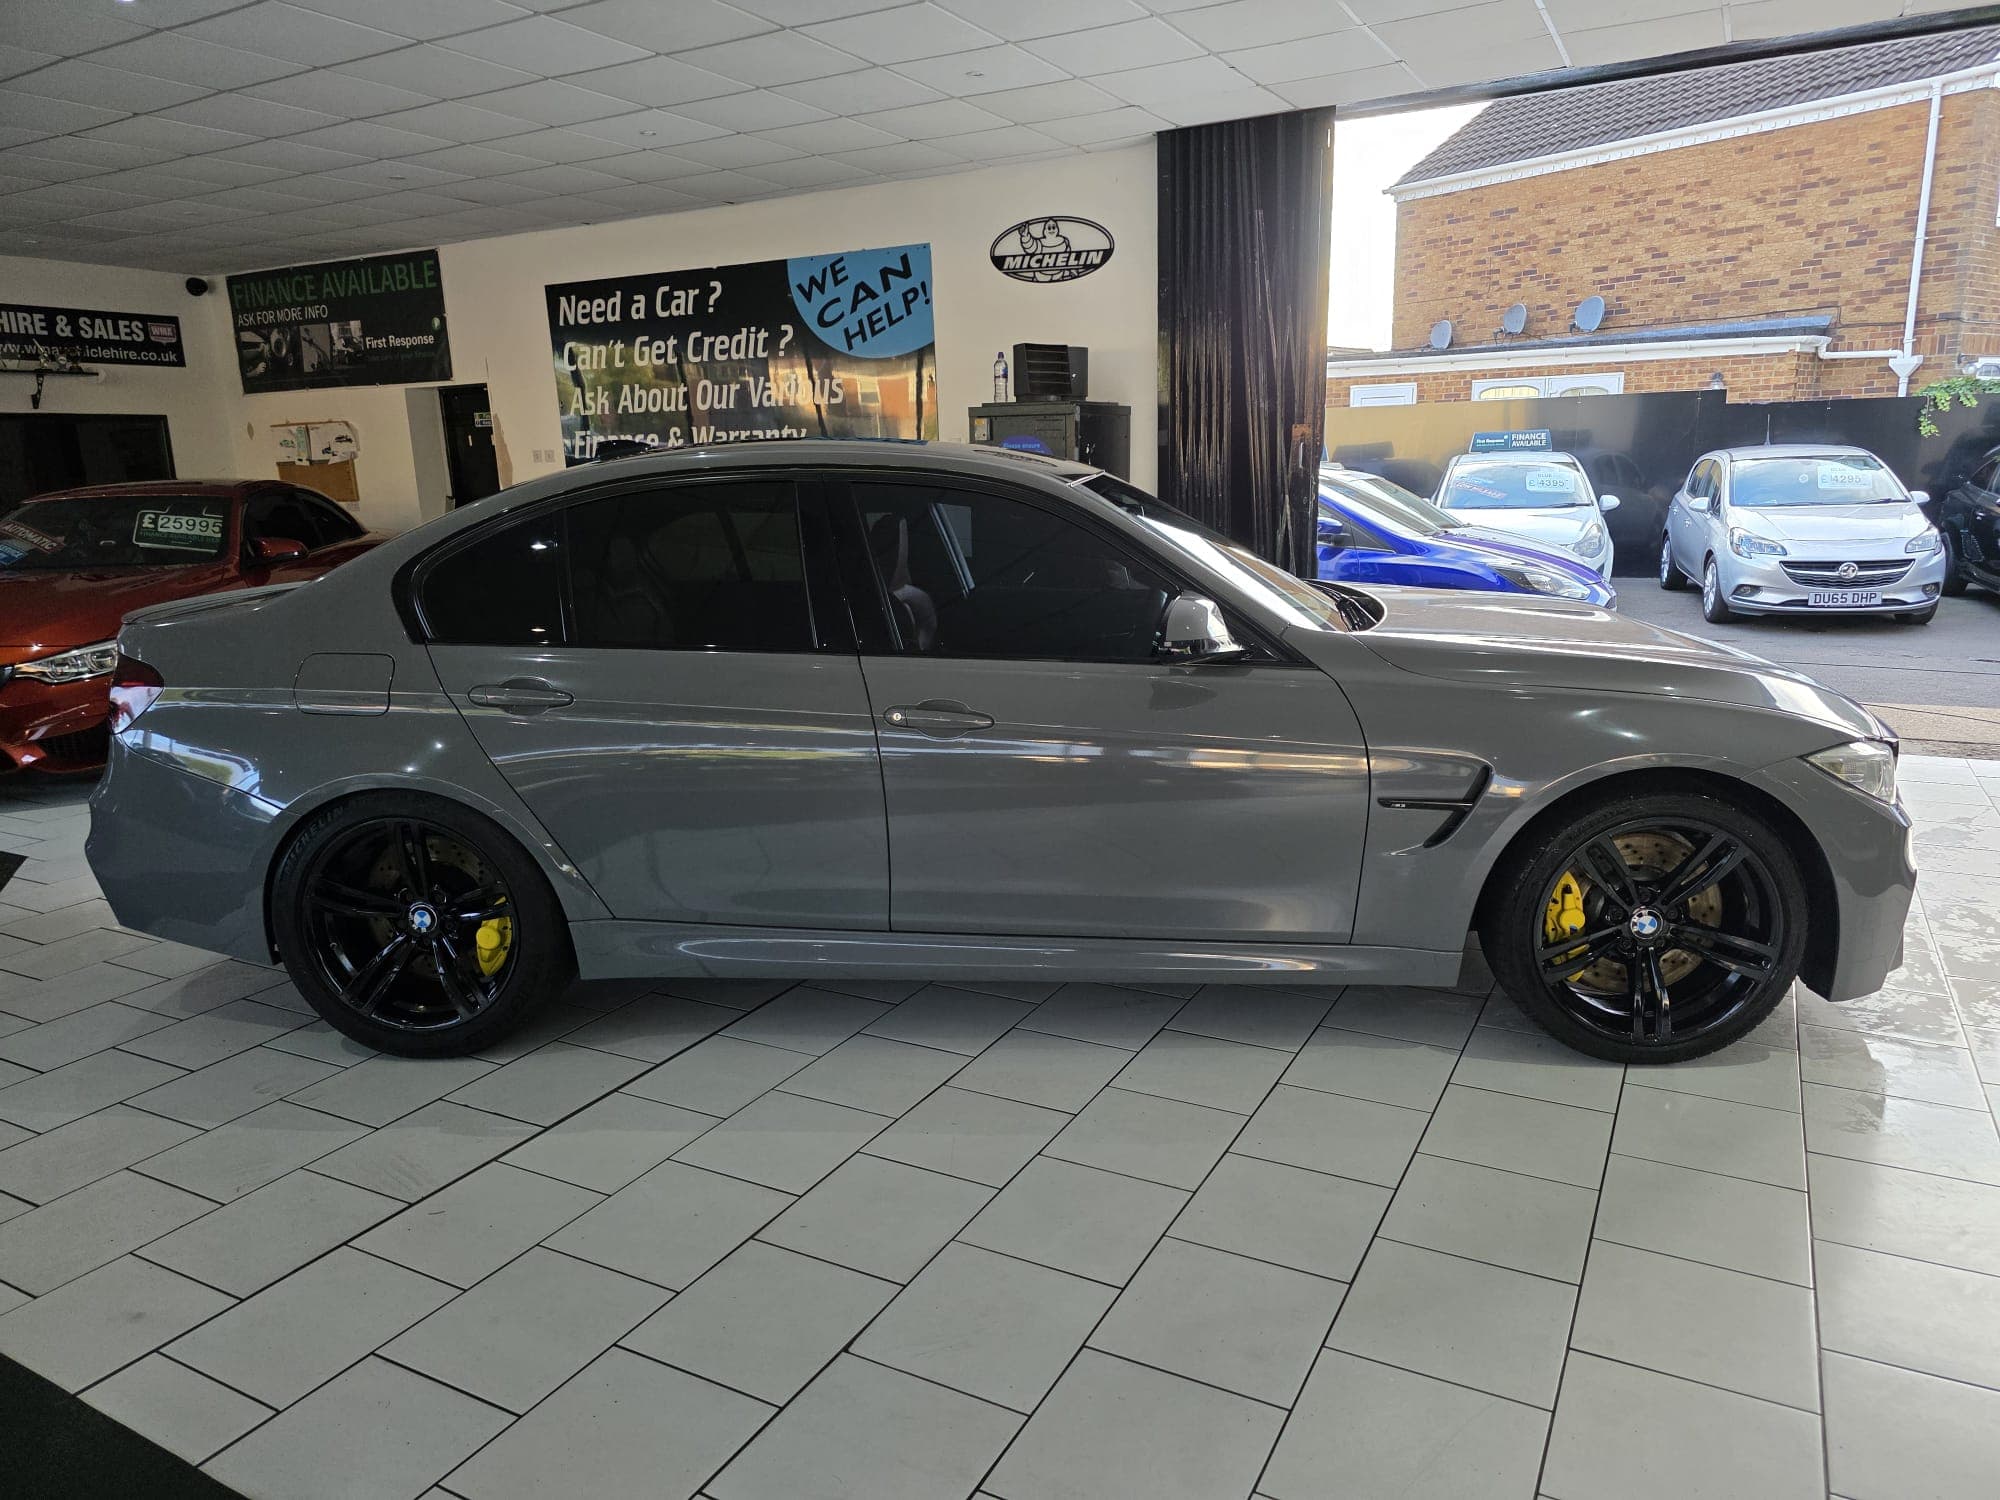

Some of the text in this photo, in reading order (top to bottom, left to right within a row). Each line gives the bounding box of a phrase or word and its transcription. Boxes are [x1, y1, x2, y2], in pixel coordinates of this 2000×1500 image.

[1003, 250, 1104, 270] MICHELIN
[232, 259, 438, 308] FINANCE AVAILABLE
[796, 256, 849, 303] WE
[817, 253, 913, 328] CAN
[238, 304, 328, 327] ASK FOR MORE INFO
[558, 280, 722, 327] Need a Car ?
[843, 280, 931, 351] HELP!
[55, 315, 73, 337] &
[78, 316, 145, 342] SALES
[366, 333, 435, 350] First Response
[562, 324, 794, 371] Can't Get Credit ?
[570, 374, 845, 416] Ask About Our Various
[668, 426, 684, 447] &
[1511, 432, 1547, 441] FINANCE
[1511, 439, 1547, 448] AVAILABLE
[3, 522, 58, 550] AUTOMATIC
[1813, 592, 1877, 604] DU65 DHP
